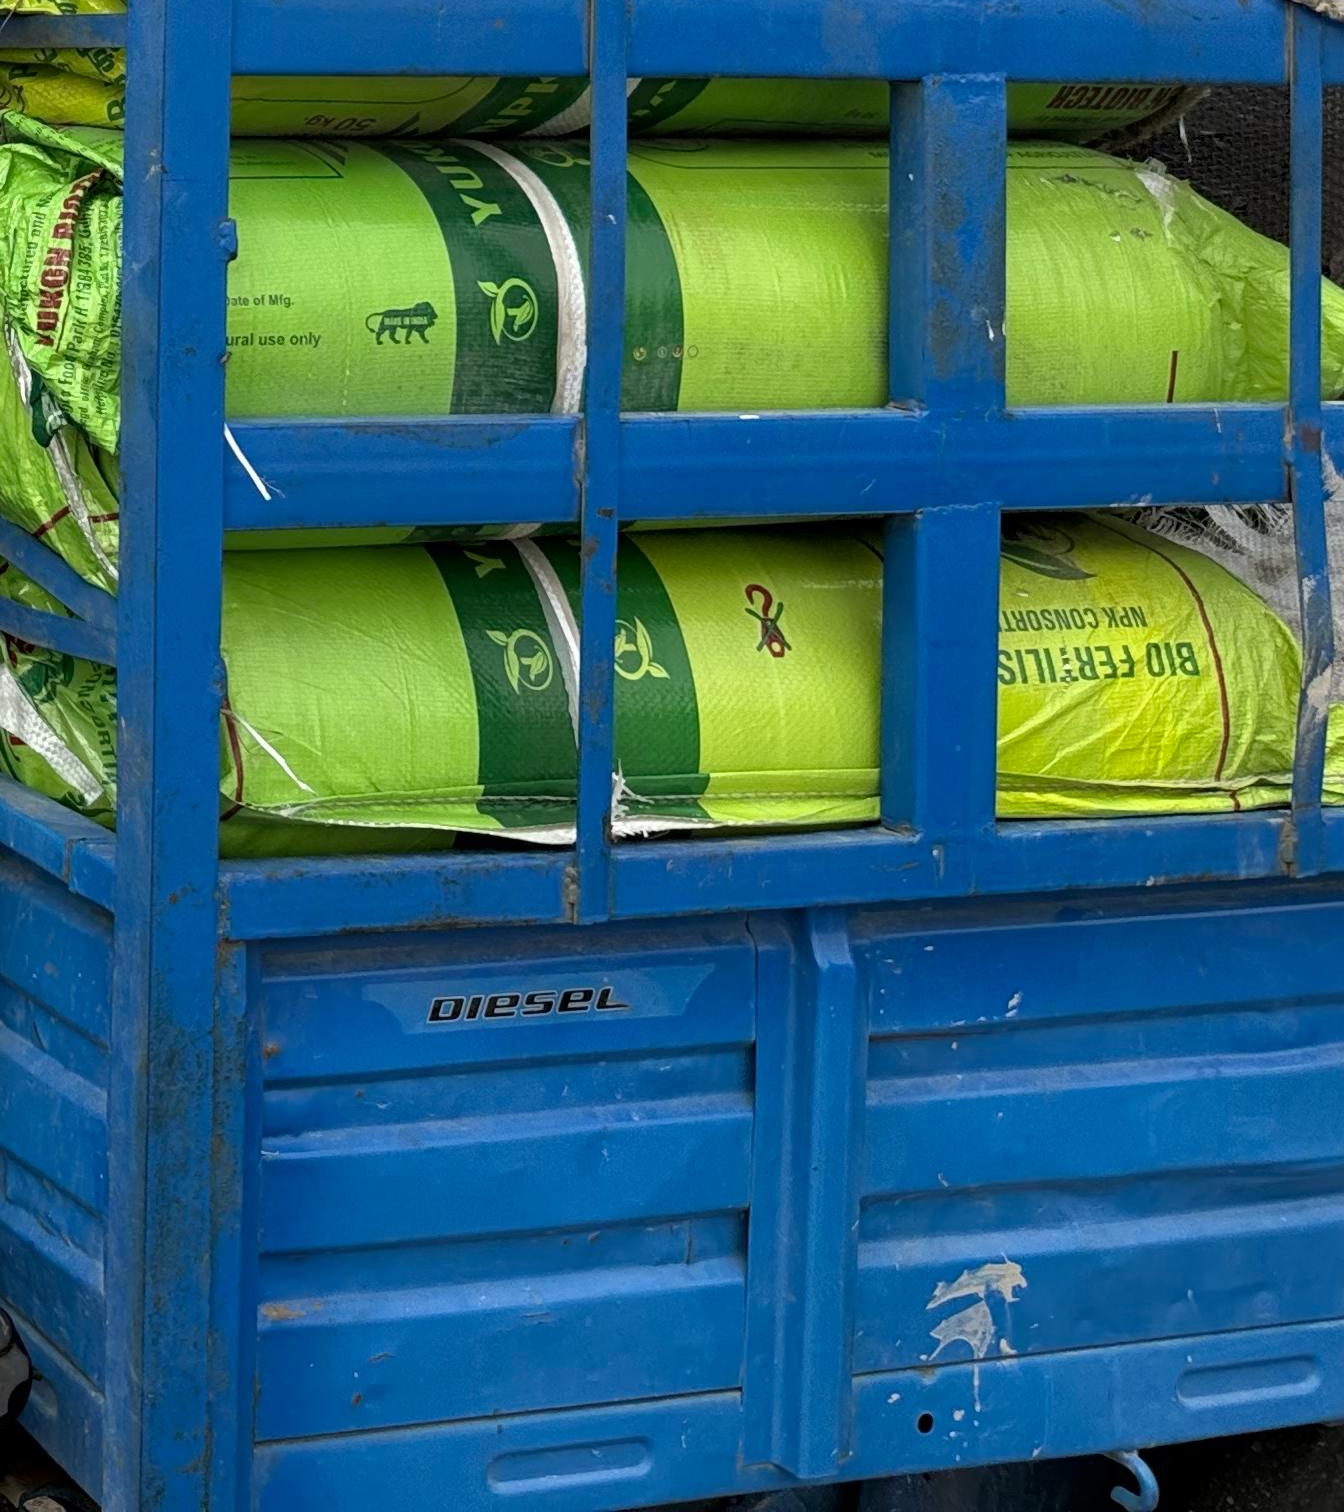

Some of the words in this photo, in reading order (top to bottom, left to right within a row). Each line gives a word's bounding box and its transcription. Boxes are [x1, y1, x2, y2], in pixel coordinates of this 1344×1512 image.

[333, 117, 377, 132] 50
[31, 211, 46, 238] and
[252, 294, 266, 308] of
[268, 294, 295, 308] Mfg.
[66, 318, 88, 354] Park
[258, 335, 286, 347] use
[289, 333, 321, 348] only
[998, 607, 1099, 633] CONSORT
[1102, 605, 1148, 630] NPK
[997, 644, 1136, 686] FERTILIS
[1145, 641, 1200, 677] BIO
[427, 987, 631, 1023] DIESEL
